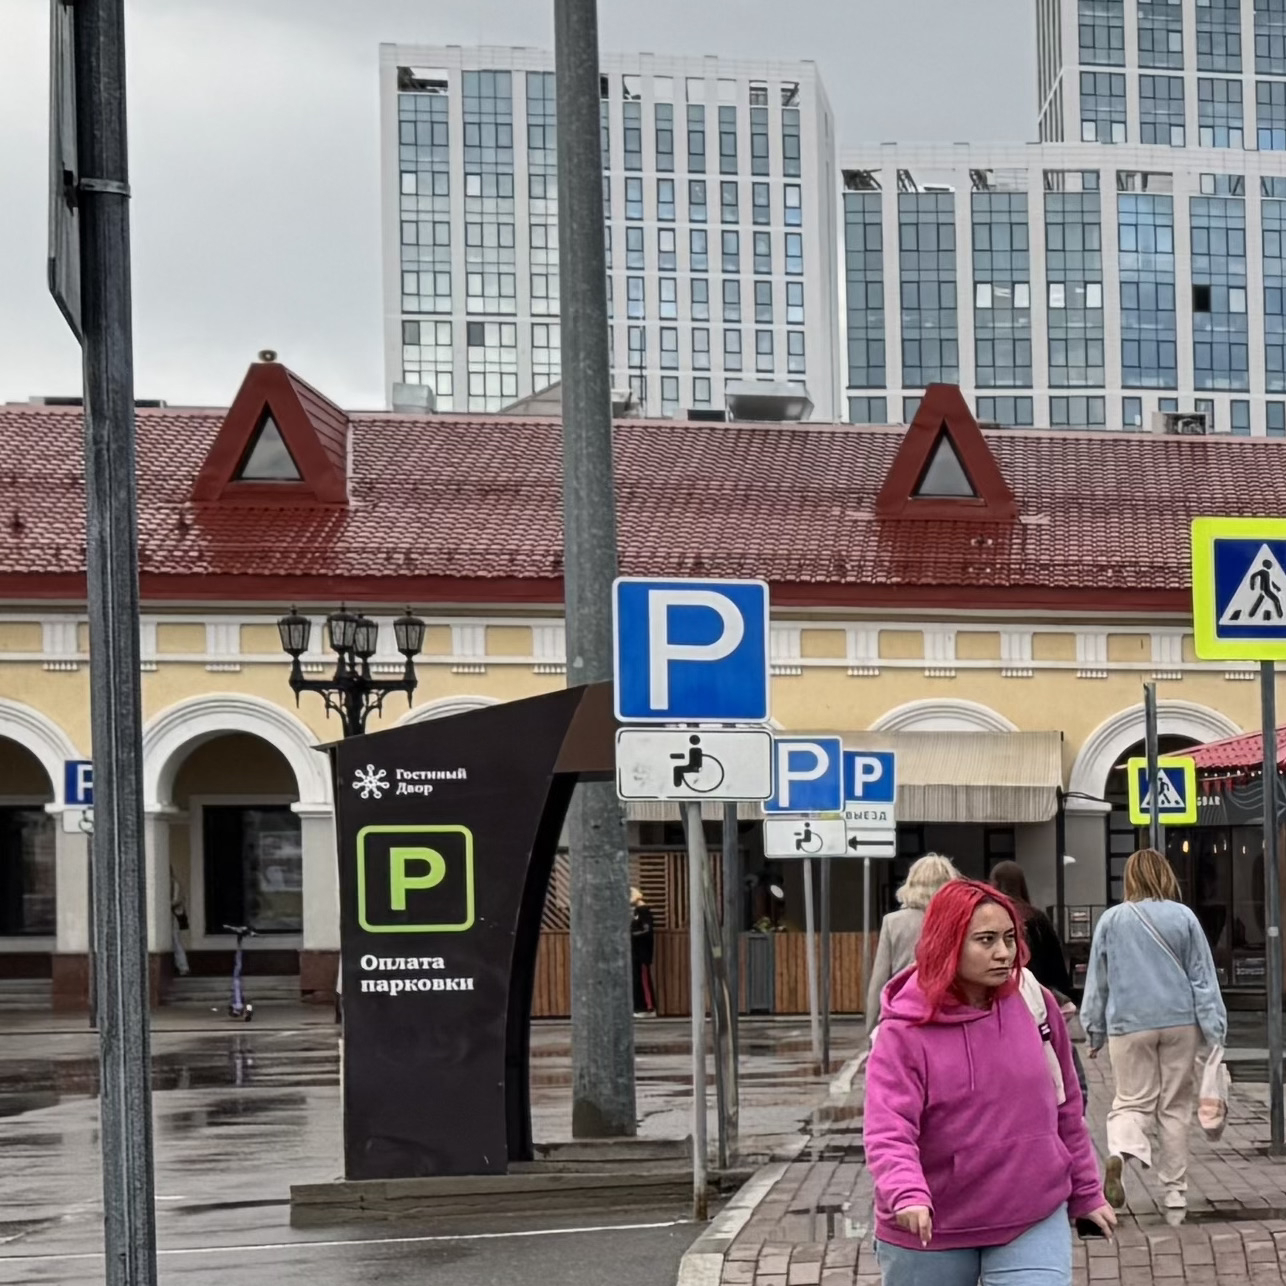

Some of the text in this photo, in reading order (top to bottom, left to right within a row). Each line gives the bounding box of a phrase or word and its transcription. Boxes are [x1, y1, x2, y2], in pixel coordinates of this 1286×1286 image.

[649, 590, 745, 710] P
[396, 768, 467, 780] Гостиный
[778, 743, 830, 808] P
[855, 756, 883, 797] P
[396, 783, 433, 796] Двор
[1197, 796, 1221, 806] GBAR
[389, 847, 446, 911] P
[360, 954, 446, 971] Оплата
[360, 977, 475, 996] парковки
